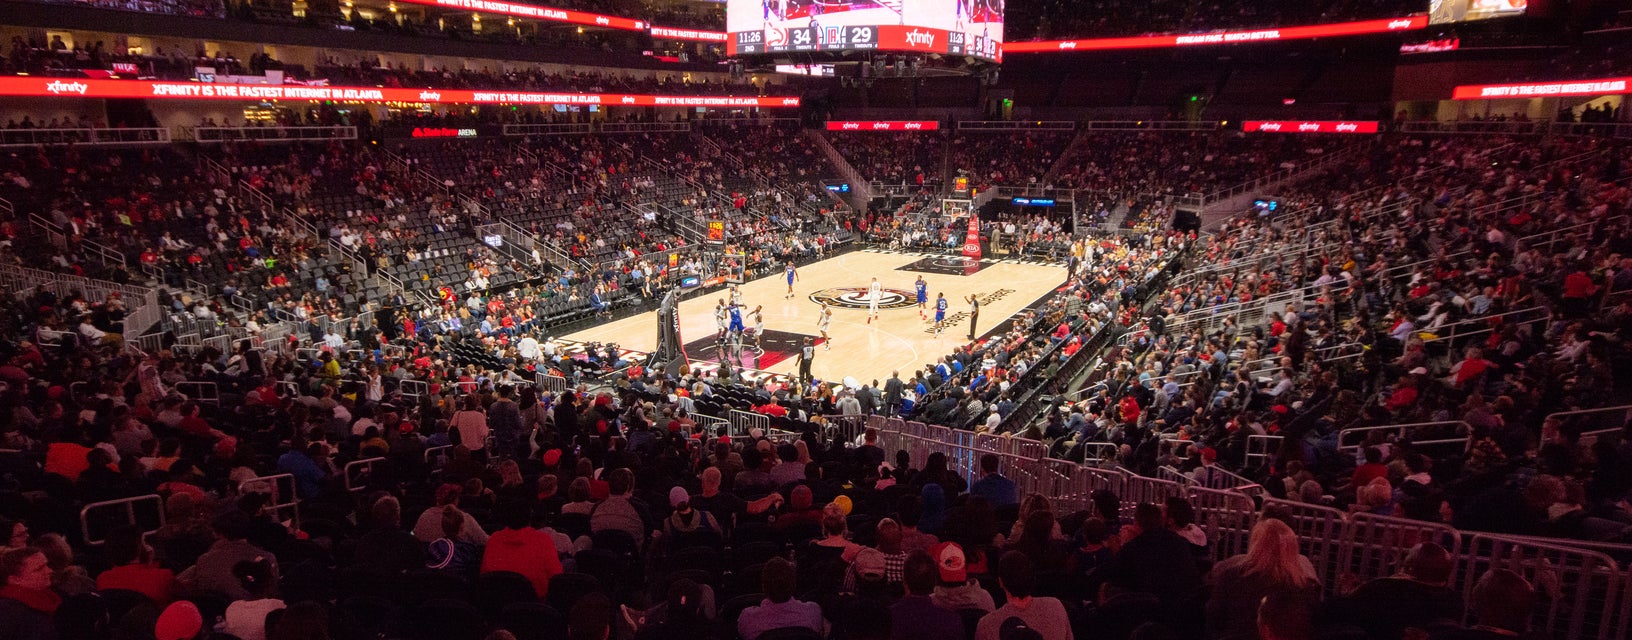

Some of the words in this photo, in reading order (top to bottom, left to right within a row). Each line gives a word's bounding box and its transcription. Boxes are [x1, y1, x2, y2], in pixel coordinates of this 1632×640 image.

[471, 0, 484, 9] THE
[485, 2, 509, 12] FASTEST
[509, 5, 537, 16] INTERNET
[544, 8, 567, 20] ATLANTA
[678, 30, 698, 39] FASTEST
[739, 32, 761, 43] 11:26
[793, 29, 811, 44] 34
[852, 27, 871, 43] 29
[906, 28, 934, 48] xfinity
[1177, 36, 1204, 45] STREAM
[1224, 33, 1250, 42] WATCH
[1250, 30, 1280, 41] BETTER.
[47, 80, 87, 94] xfinity
[153, 84, 199, 95] XFINITY
[202, 85, 214, 95] IS
[215, 85, 238, 96] THE
[239, 87, 282, 97] FASTEST
[284, 88, 331, 98] INTERNET
[332, 89, 342, 98] IN
[343, 89, 383, 99] ATLANTA
[1482, 87, 1510, 96] XFINITY
[1519, 87, 1535, 95] THE
[1534, 85, 1561, 94] FASTEST
[419, 91, 440, 101] xfinity
[474, 92, 498, 101] XFINITY
[499, 93, 506, 102] IS
[507, 93, 519, 103] THE
[520, 93, 544, 104] FASTEST
[545, 94, 571, 104] INTERNET
[572, 95, 578, 104] IN
[578, 95, 601, 104] ATLANTA
